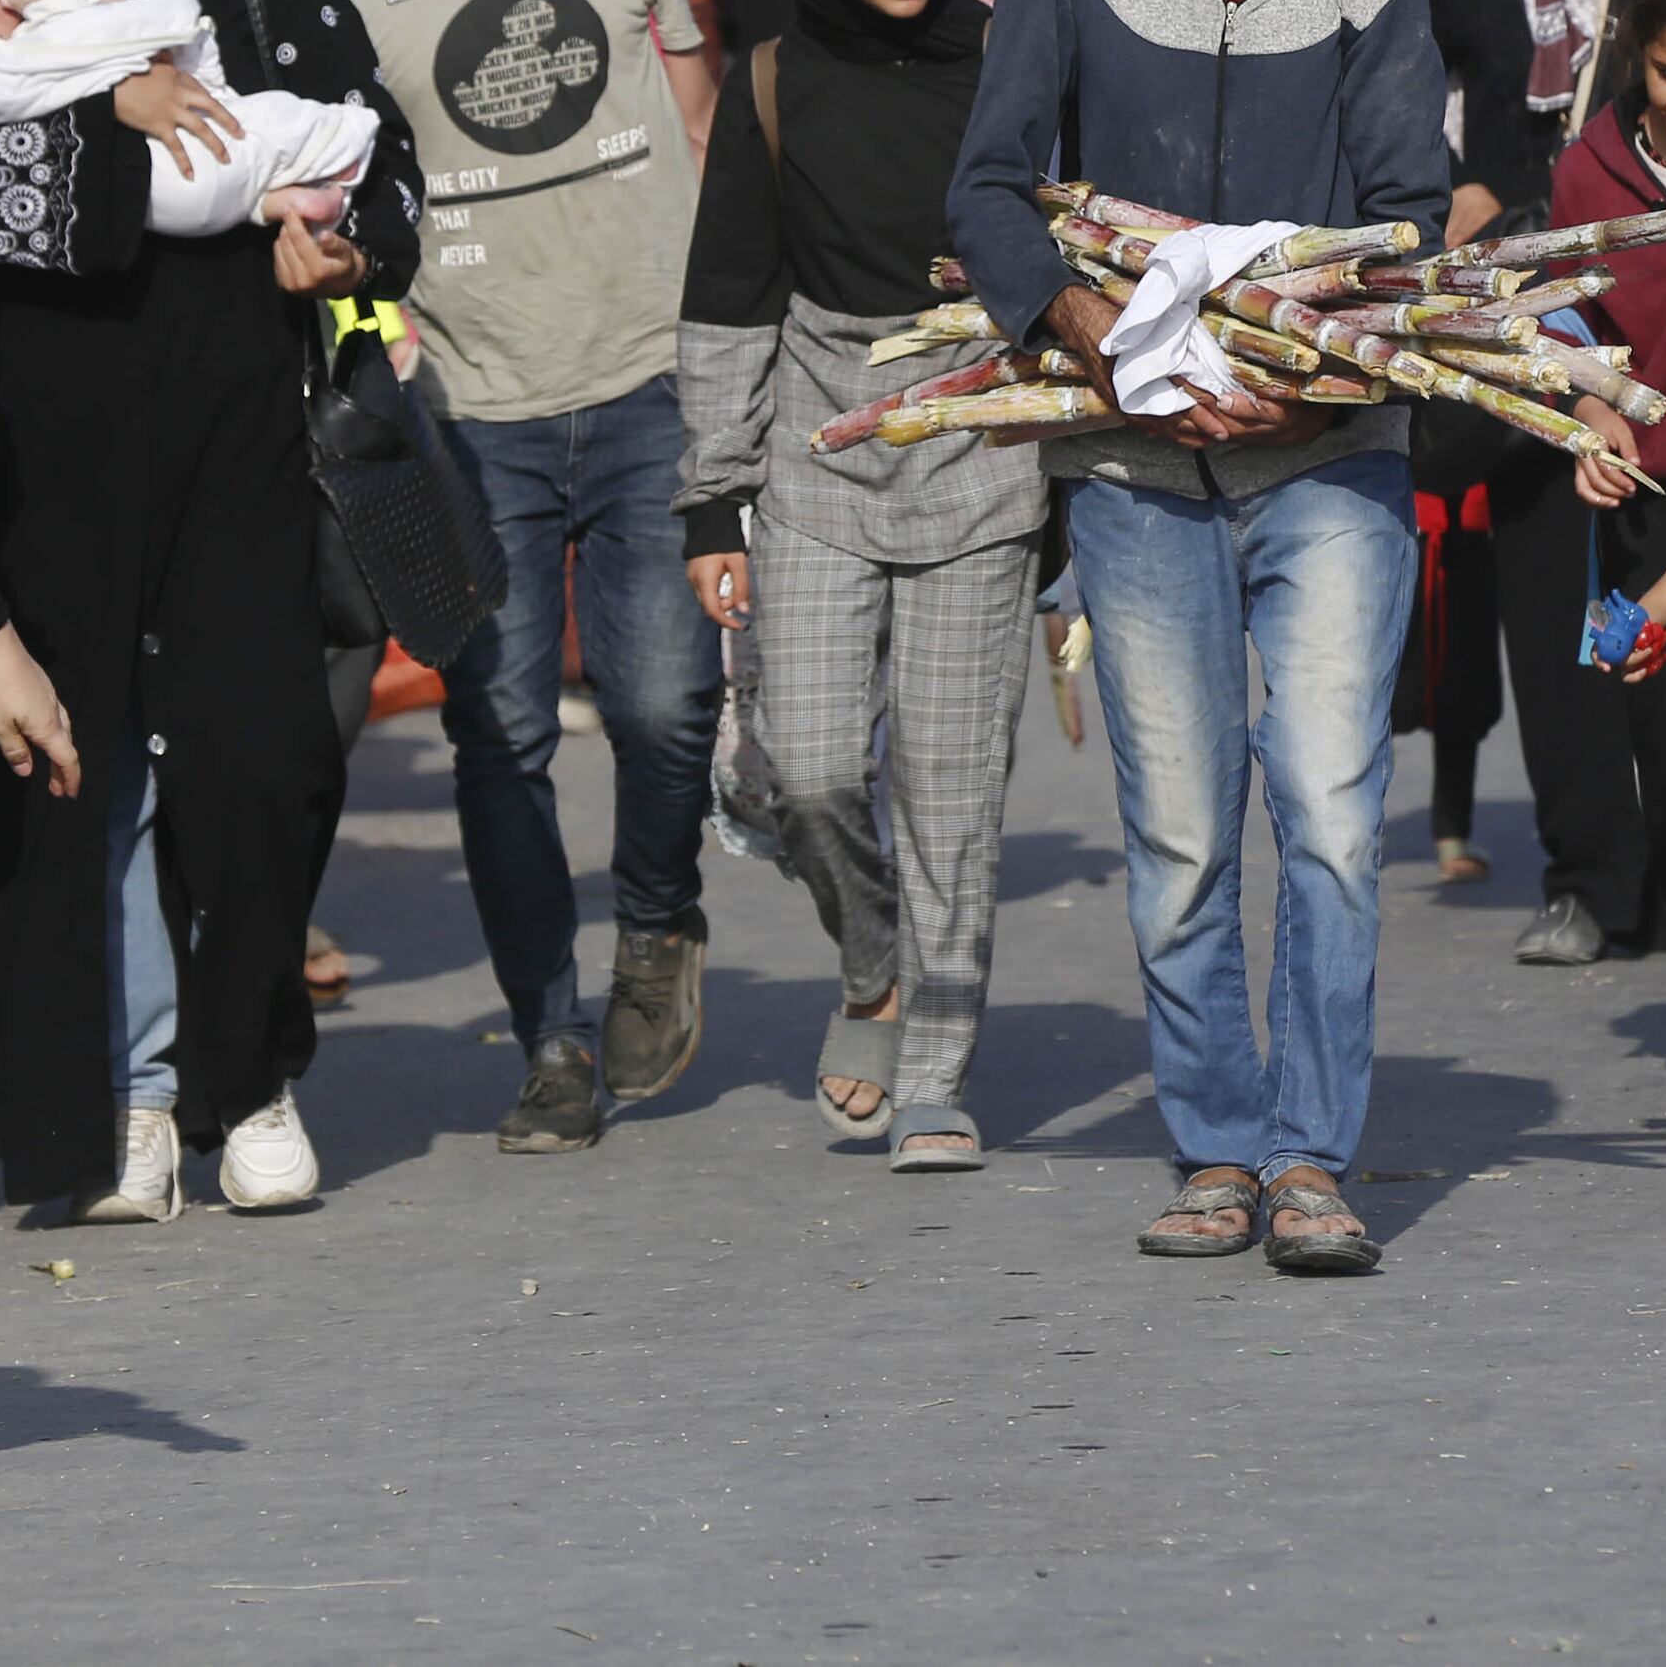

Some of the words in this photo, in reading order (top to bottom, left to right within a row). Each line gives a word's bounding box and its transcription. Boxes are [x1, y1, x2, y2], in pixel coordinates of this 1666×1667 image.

[596, 123, 647, 160] SLEEPS
[425, 172, 455, 194] THE
[458, 165, 500, 191] CITY
[430, 208, 471, 231] THAT
[439, 243, 488, 266] NEVER
